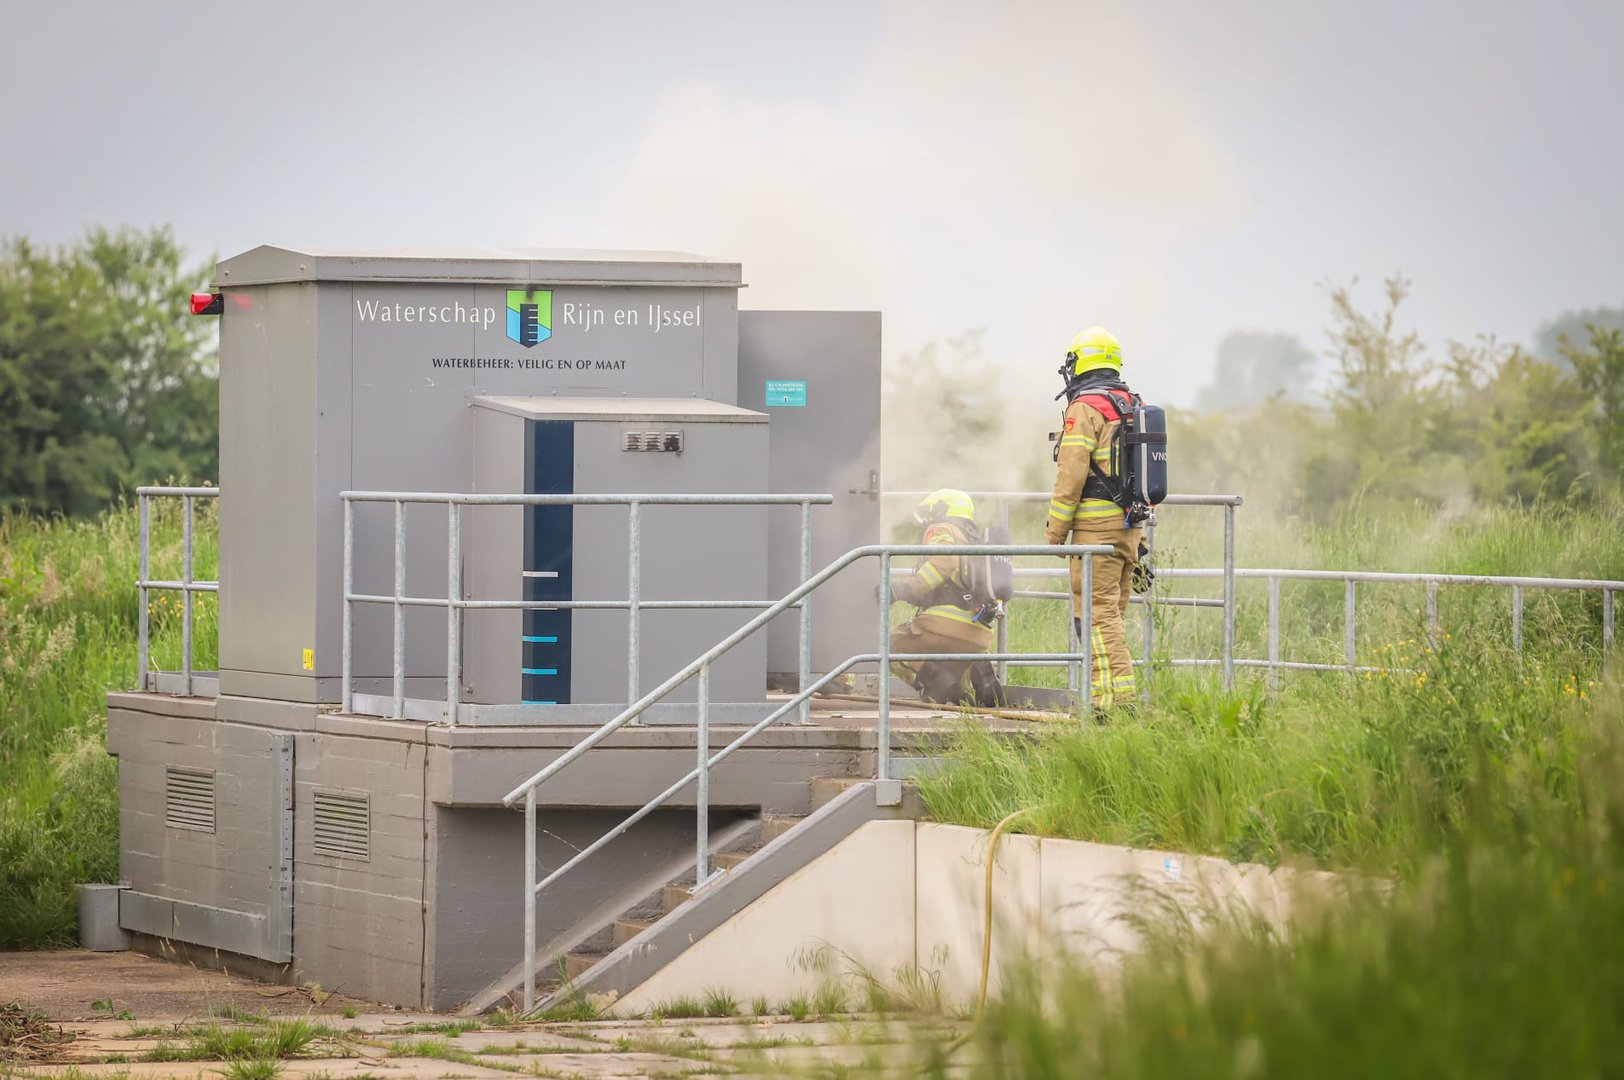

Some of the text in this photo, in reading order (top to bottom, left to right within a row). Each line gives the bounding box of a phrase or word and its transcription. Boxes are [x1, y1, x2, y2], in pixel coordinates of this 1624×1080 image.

[356, 300, 701, 333] Waterschap Rijn en IJssel
[432, 358, 627, 371] WATERBEHEER: VEILIG EN OP MAAT
